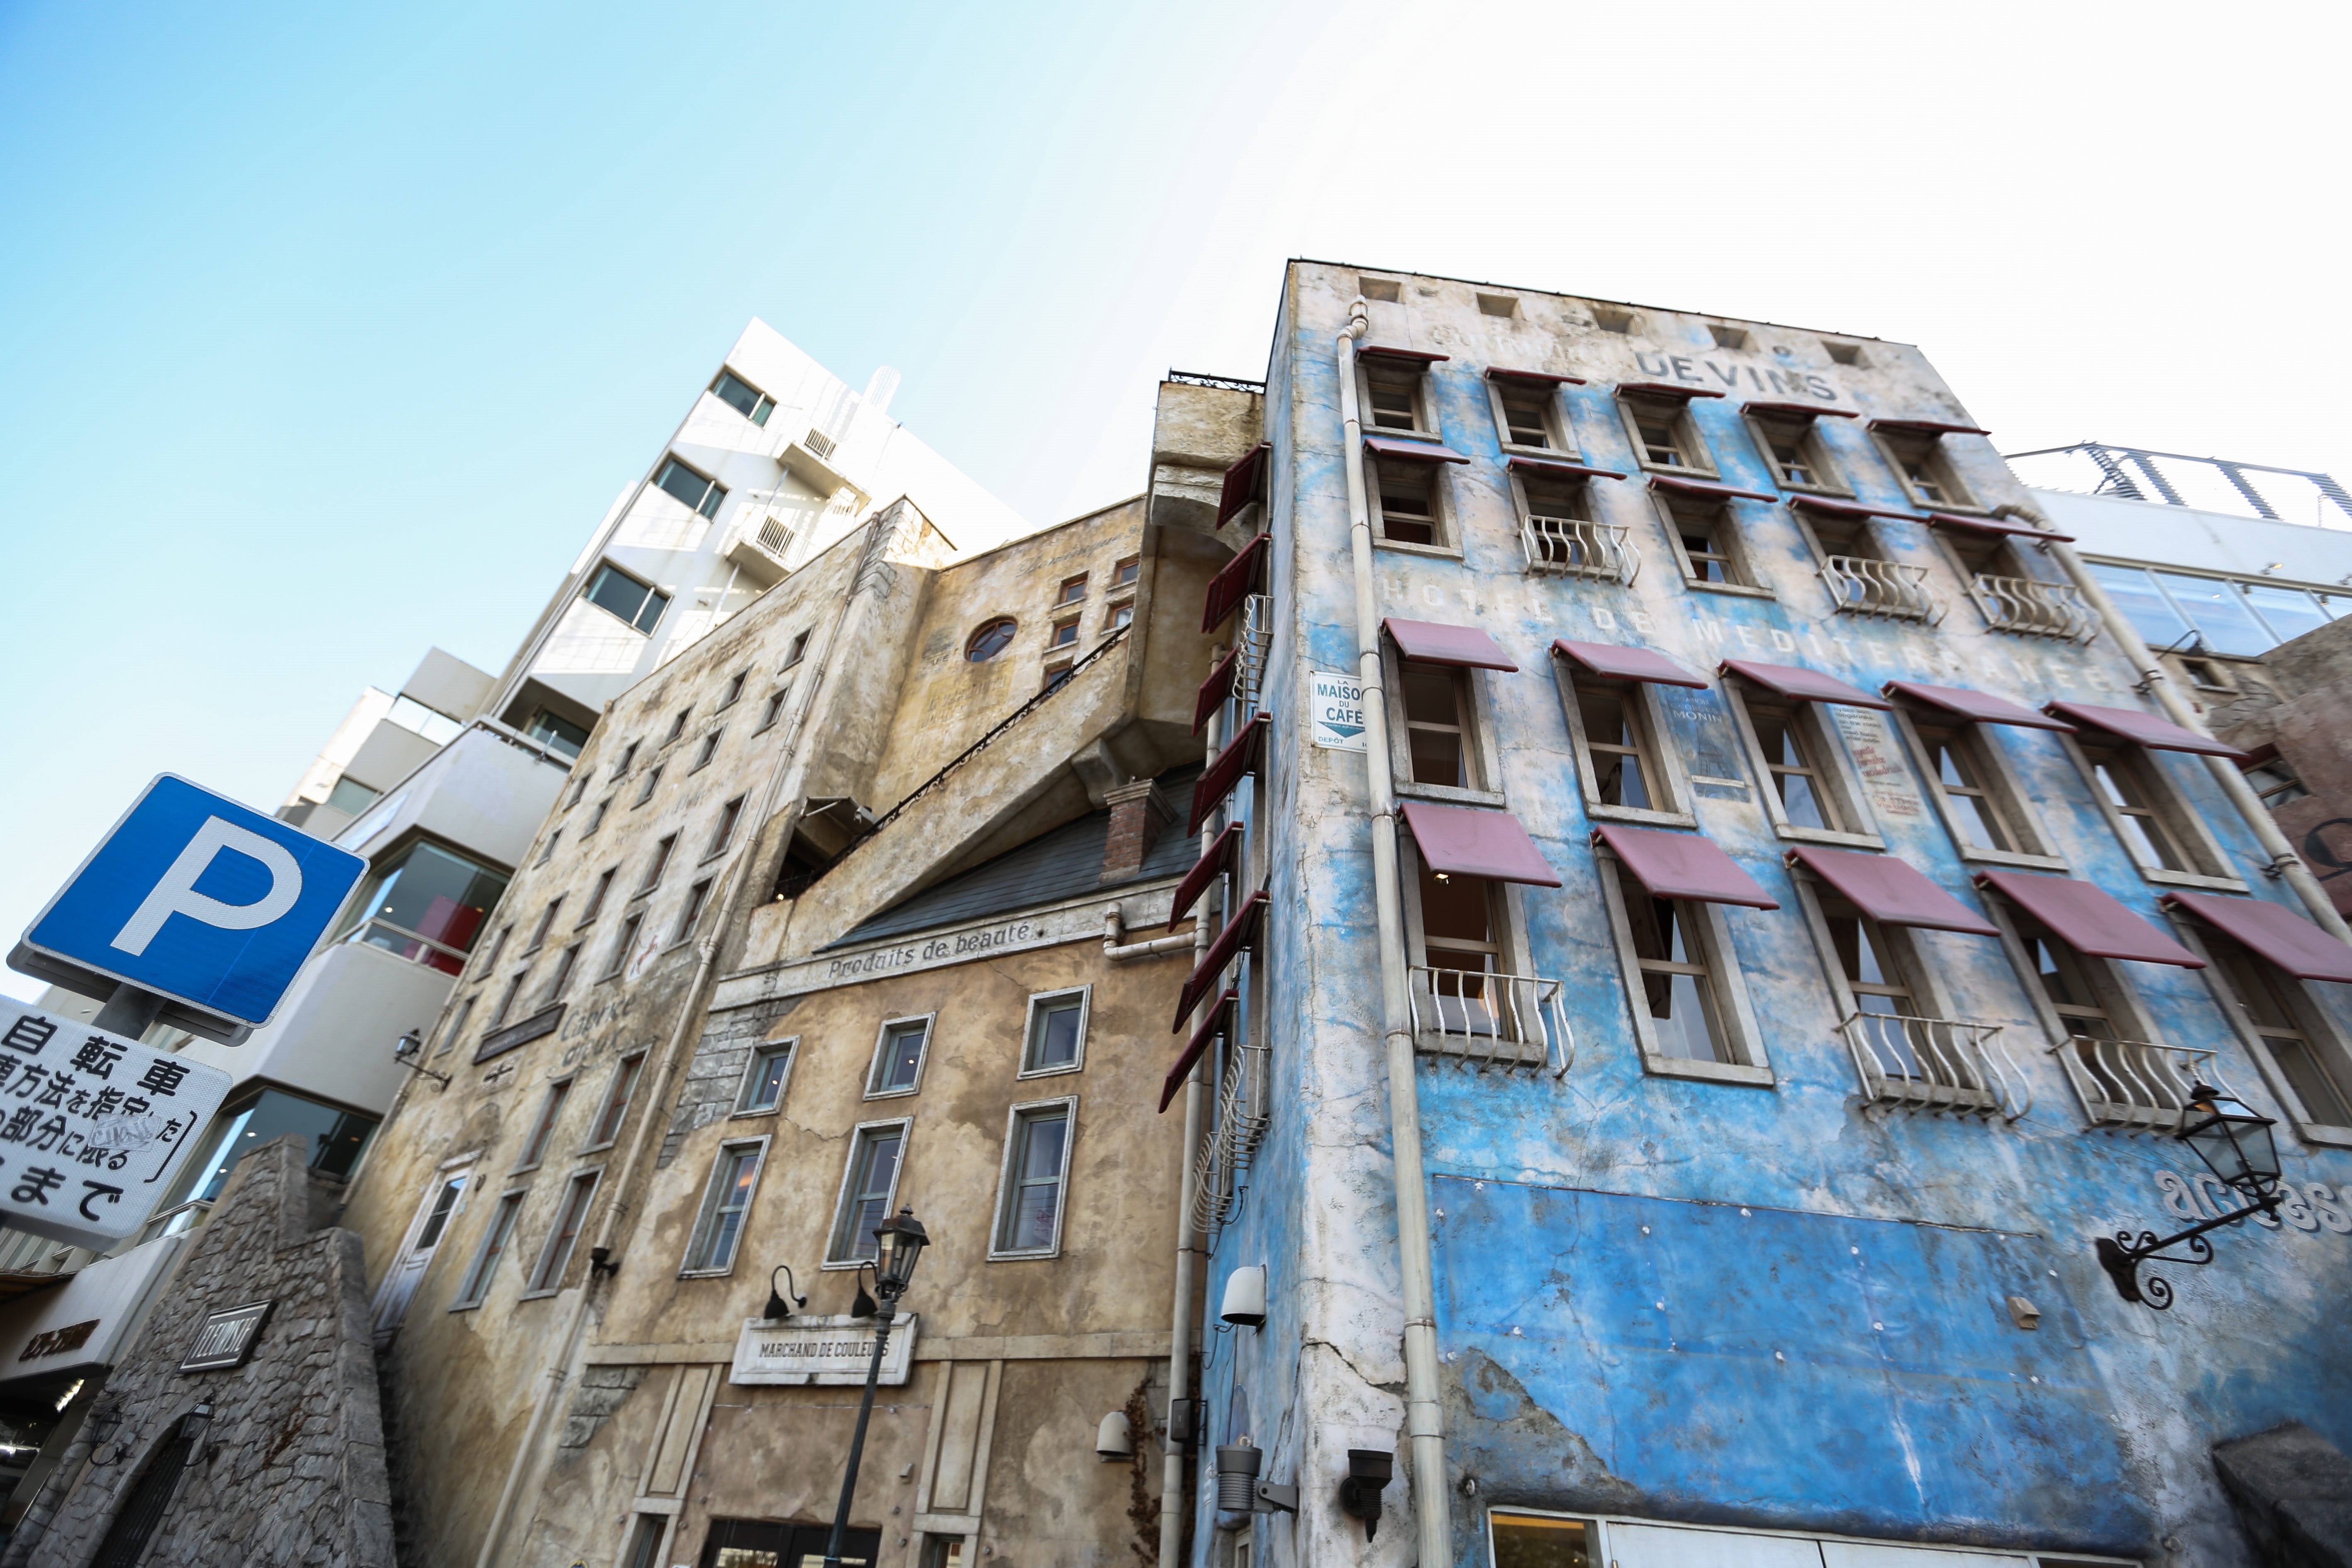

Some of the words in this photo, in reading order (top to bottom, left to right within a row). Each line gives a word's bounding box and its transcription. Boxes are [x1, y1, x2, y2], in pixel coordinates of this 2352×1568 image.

[1383, 579, 1555, 622] HOTEL
[1592, 607, 1656, 634] DE
[1317, 683, 1361, 700] MAISO
[1672, 709, 1723, 723] MONIN
[110, 814, 303, 957] P
[828, 948, 915, 979] Produits
[922, 940, 949, 961] de
[955, 922, 1030, 954] beauté
[0, 1014, 190, 1097] 自転車
[0, 1054, 183, 1143] 車方法を指定た
[0, 1105, 130, 1171] 部分に限る
[0, 1156, 124, 1222] まで
[2154, 1169, 2352, 1234] acces
[190, 1316, 258, 1359] FLEURISTE
[758, 1342, 818, 1358] MARCHAND
[819, 1342, 833, 1357] DE
[834, 1341, 890, 1357] COULEUS
